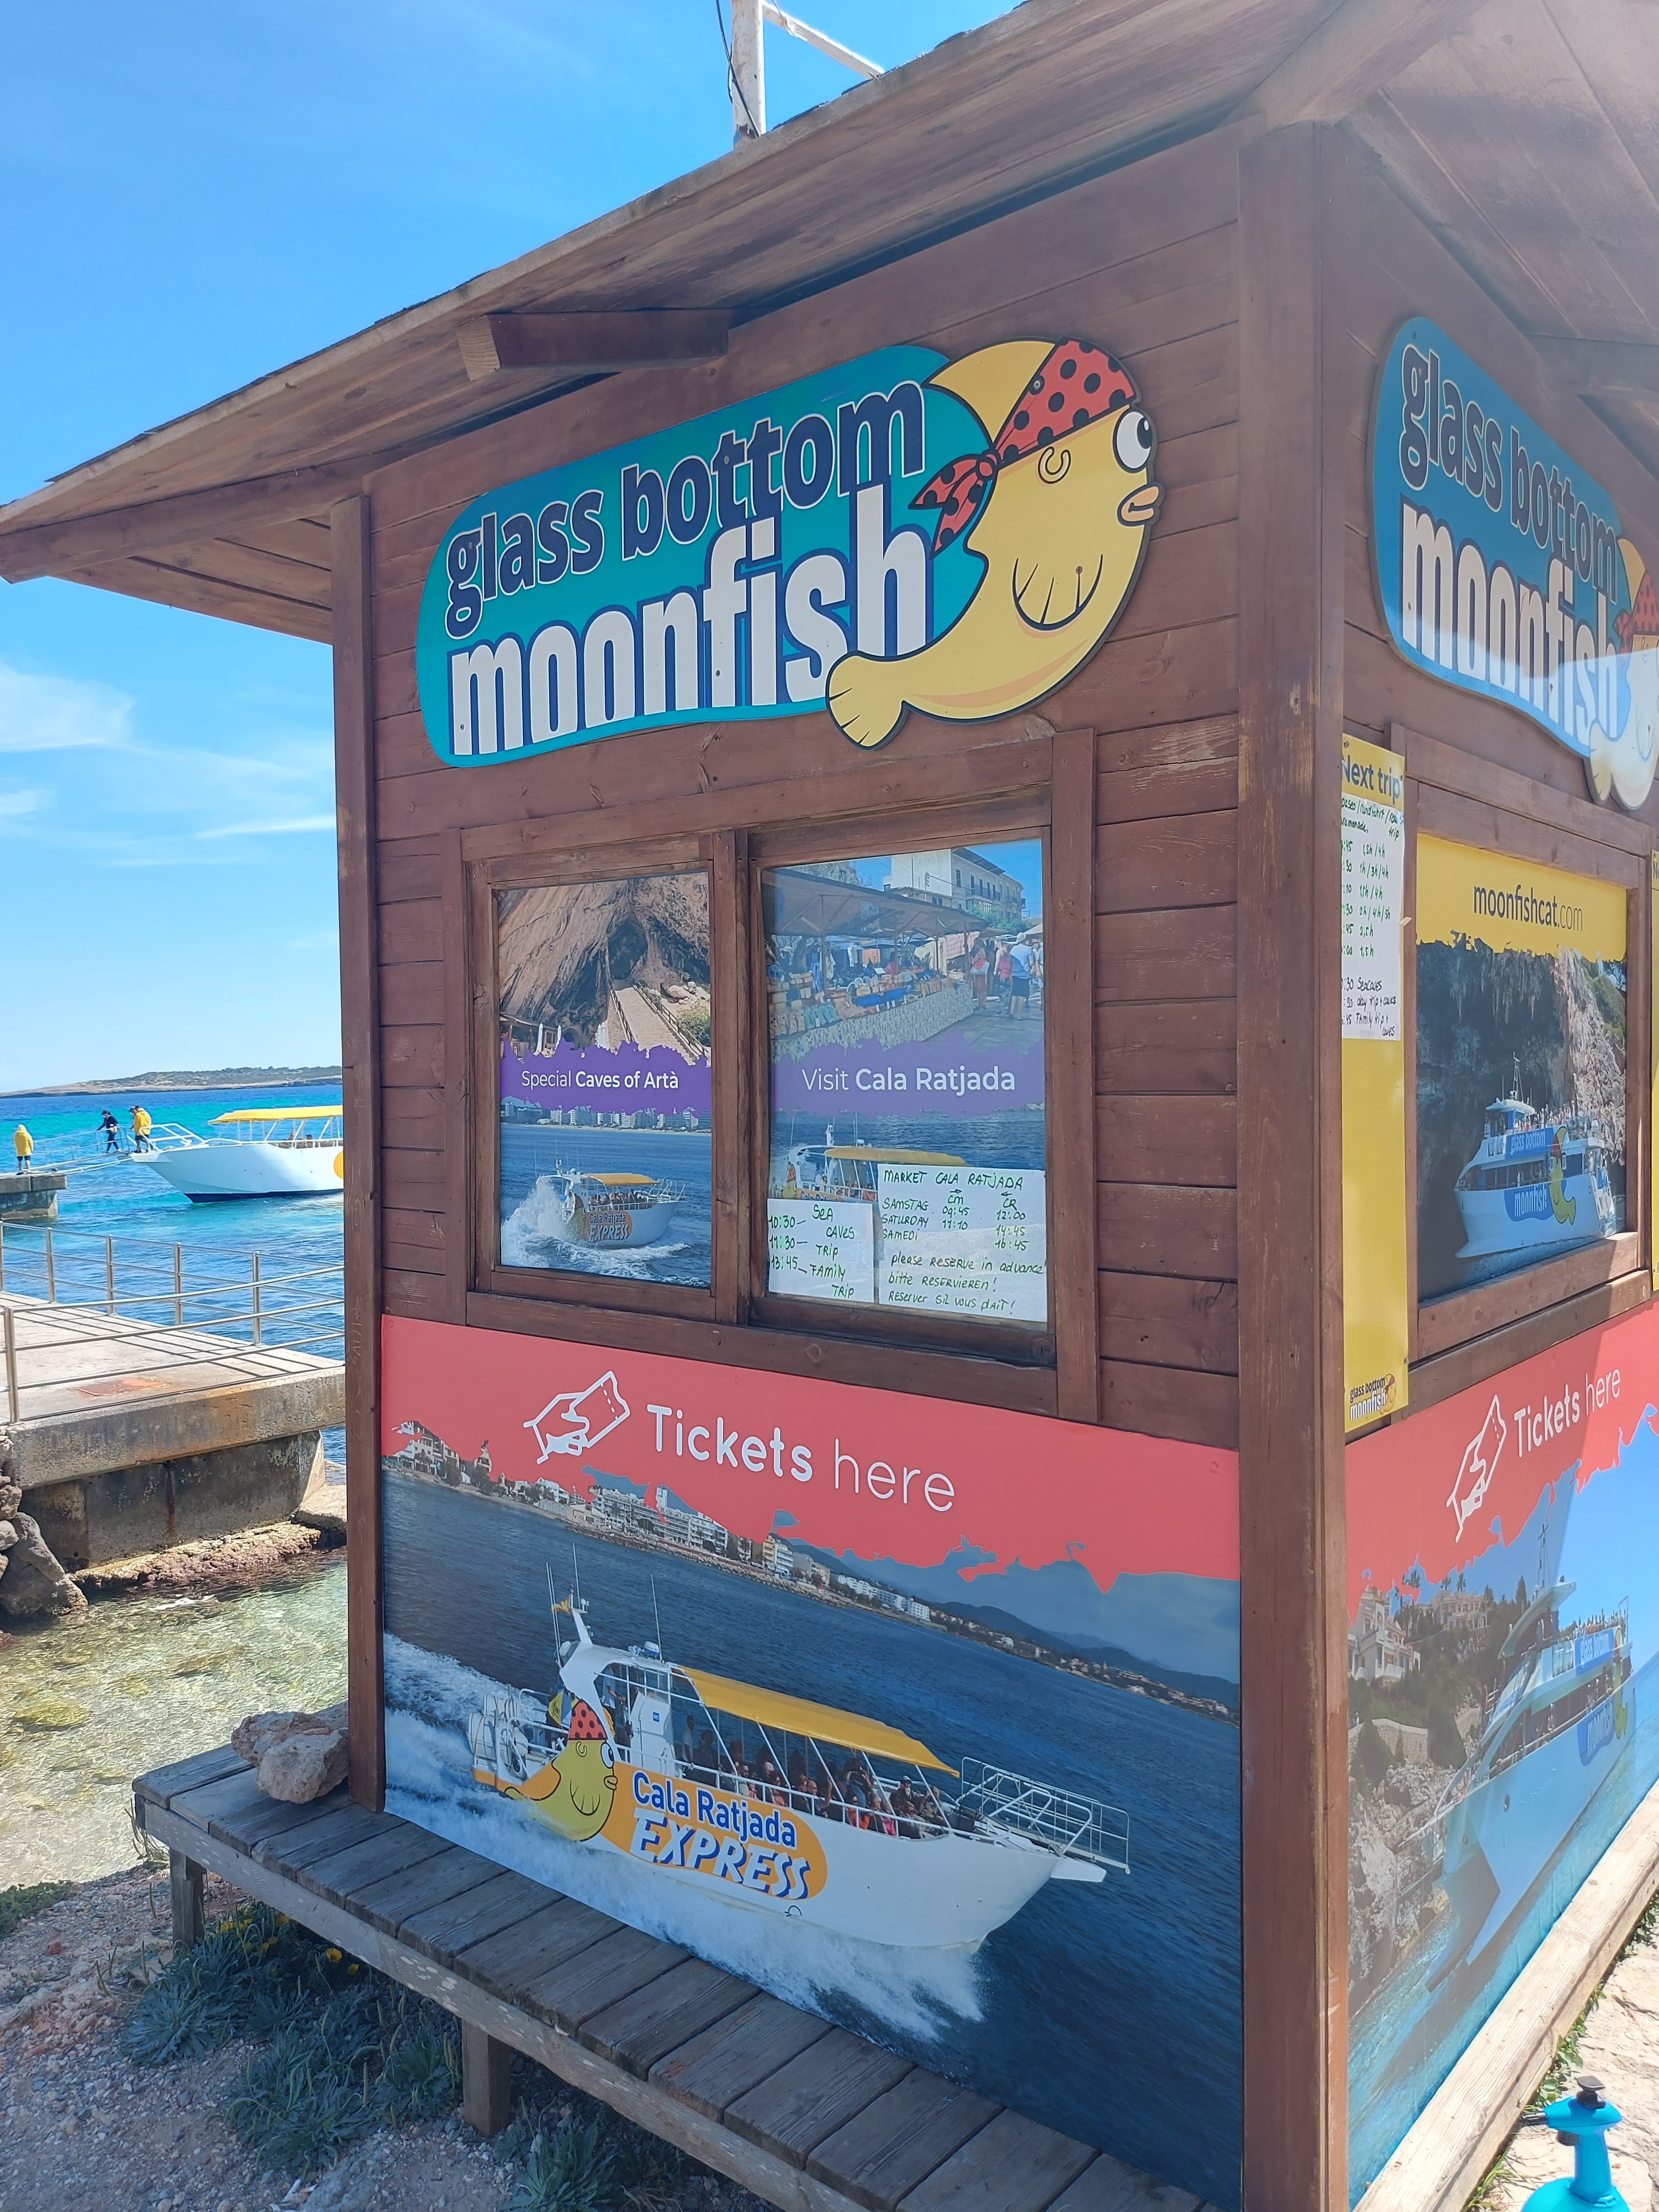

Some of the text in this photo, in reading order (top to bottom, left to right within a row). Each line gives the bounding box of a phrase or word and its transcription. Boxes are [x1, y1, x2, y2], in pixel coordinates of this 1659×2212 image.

[1400, 344, 1616, 604] glass bottom
[445, 380, 925, 638] glass bottom
[447, 483, 933, 755] moonfish
[1402, 498, 1618, 745] moonfish
[1378, 766, 1400, 805] trip
[1341, 817, 1369, 833] romenade,
[1341, 840, 1353, 852] :45
[1342, 860, 1352, 873] :30
[1342, 883, 1352, 895] :10
[1342, 903, 1353, 917] :30
[1473, 885, 1583, 931] moonfishcat.com
[1342, 923, 1354, 935] :45
[1341, 945, 1353, 956] :00
[1343, 996, 1353, 1008] :30
[521, 1070, 679, 1090] Special Caves of Artà
[802, 1065, 1016, 1096] Visit Cala Ratjada
[1510, 1128, 1546, 1156] glass bottom
[936, 1172, 959, 1184] CALA
[942, 1206, 970, 1218] 09:45
[996, 1209, 1026, 1220] 12:00
[1003, 1198, 1017, 1211] CR
[589, 1212, 626, 1225] Cala Ratjada
[768, 1215, 796, 1228] 10:30
[882, 1214, 929, 1228] SATURDAY
[996, 1225, 1026, 1237] 14:45
[589, 1225, 629, 1243] EXPRESS
[769, 1235, 795, 1250] 11:30
[771, 1254, 798, 1270] 13:45
[891, 1251, 922, 1266] please
[982, 1257, 993, 1271] in
[888, 1271, 913, 1285] bitte
[1350, 1377, 1385, 1404] glass bottom
[1349, 1387, 1386, 1420] moonfish
[1514, 1369, 1621, 1458] Tickets here
[646, 1404, 955, 1512] Tickets here
[633, 1770, 797, 1850] Cala Ratjada
[630, 1806, 811, 1900] EXPRESS
